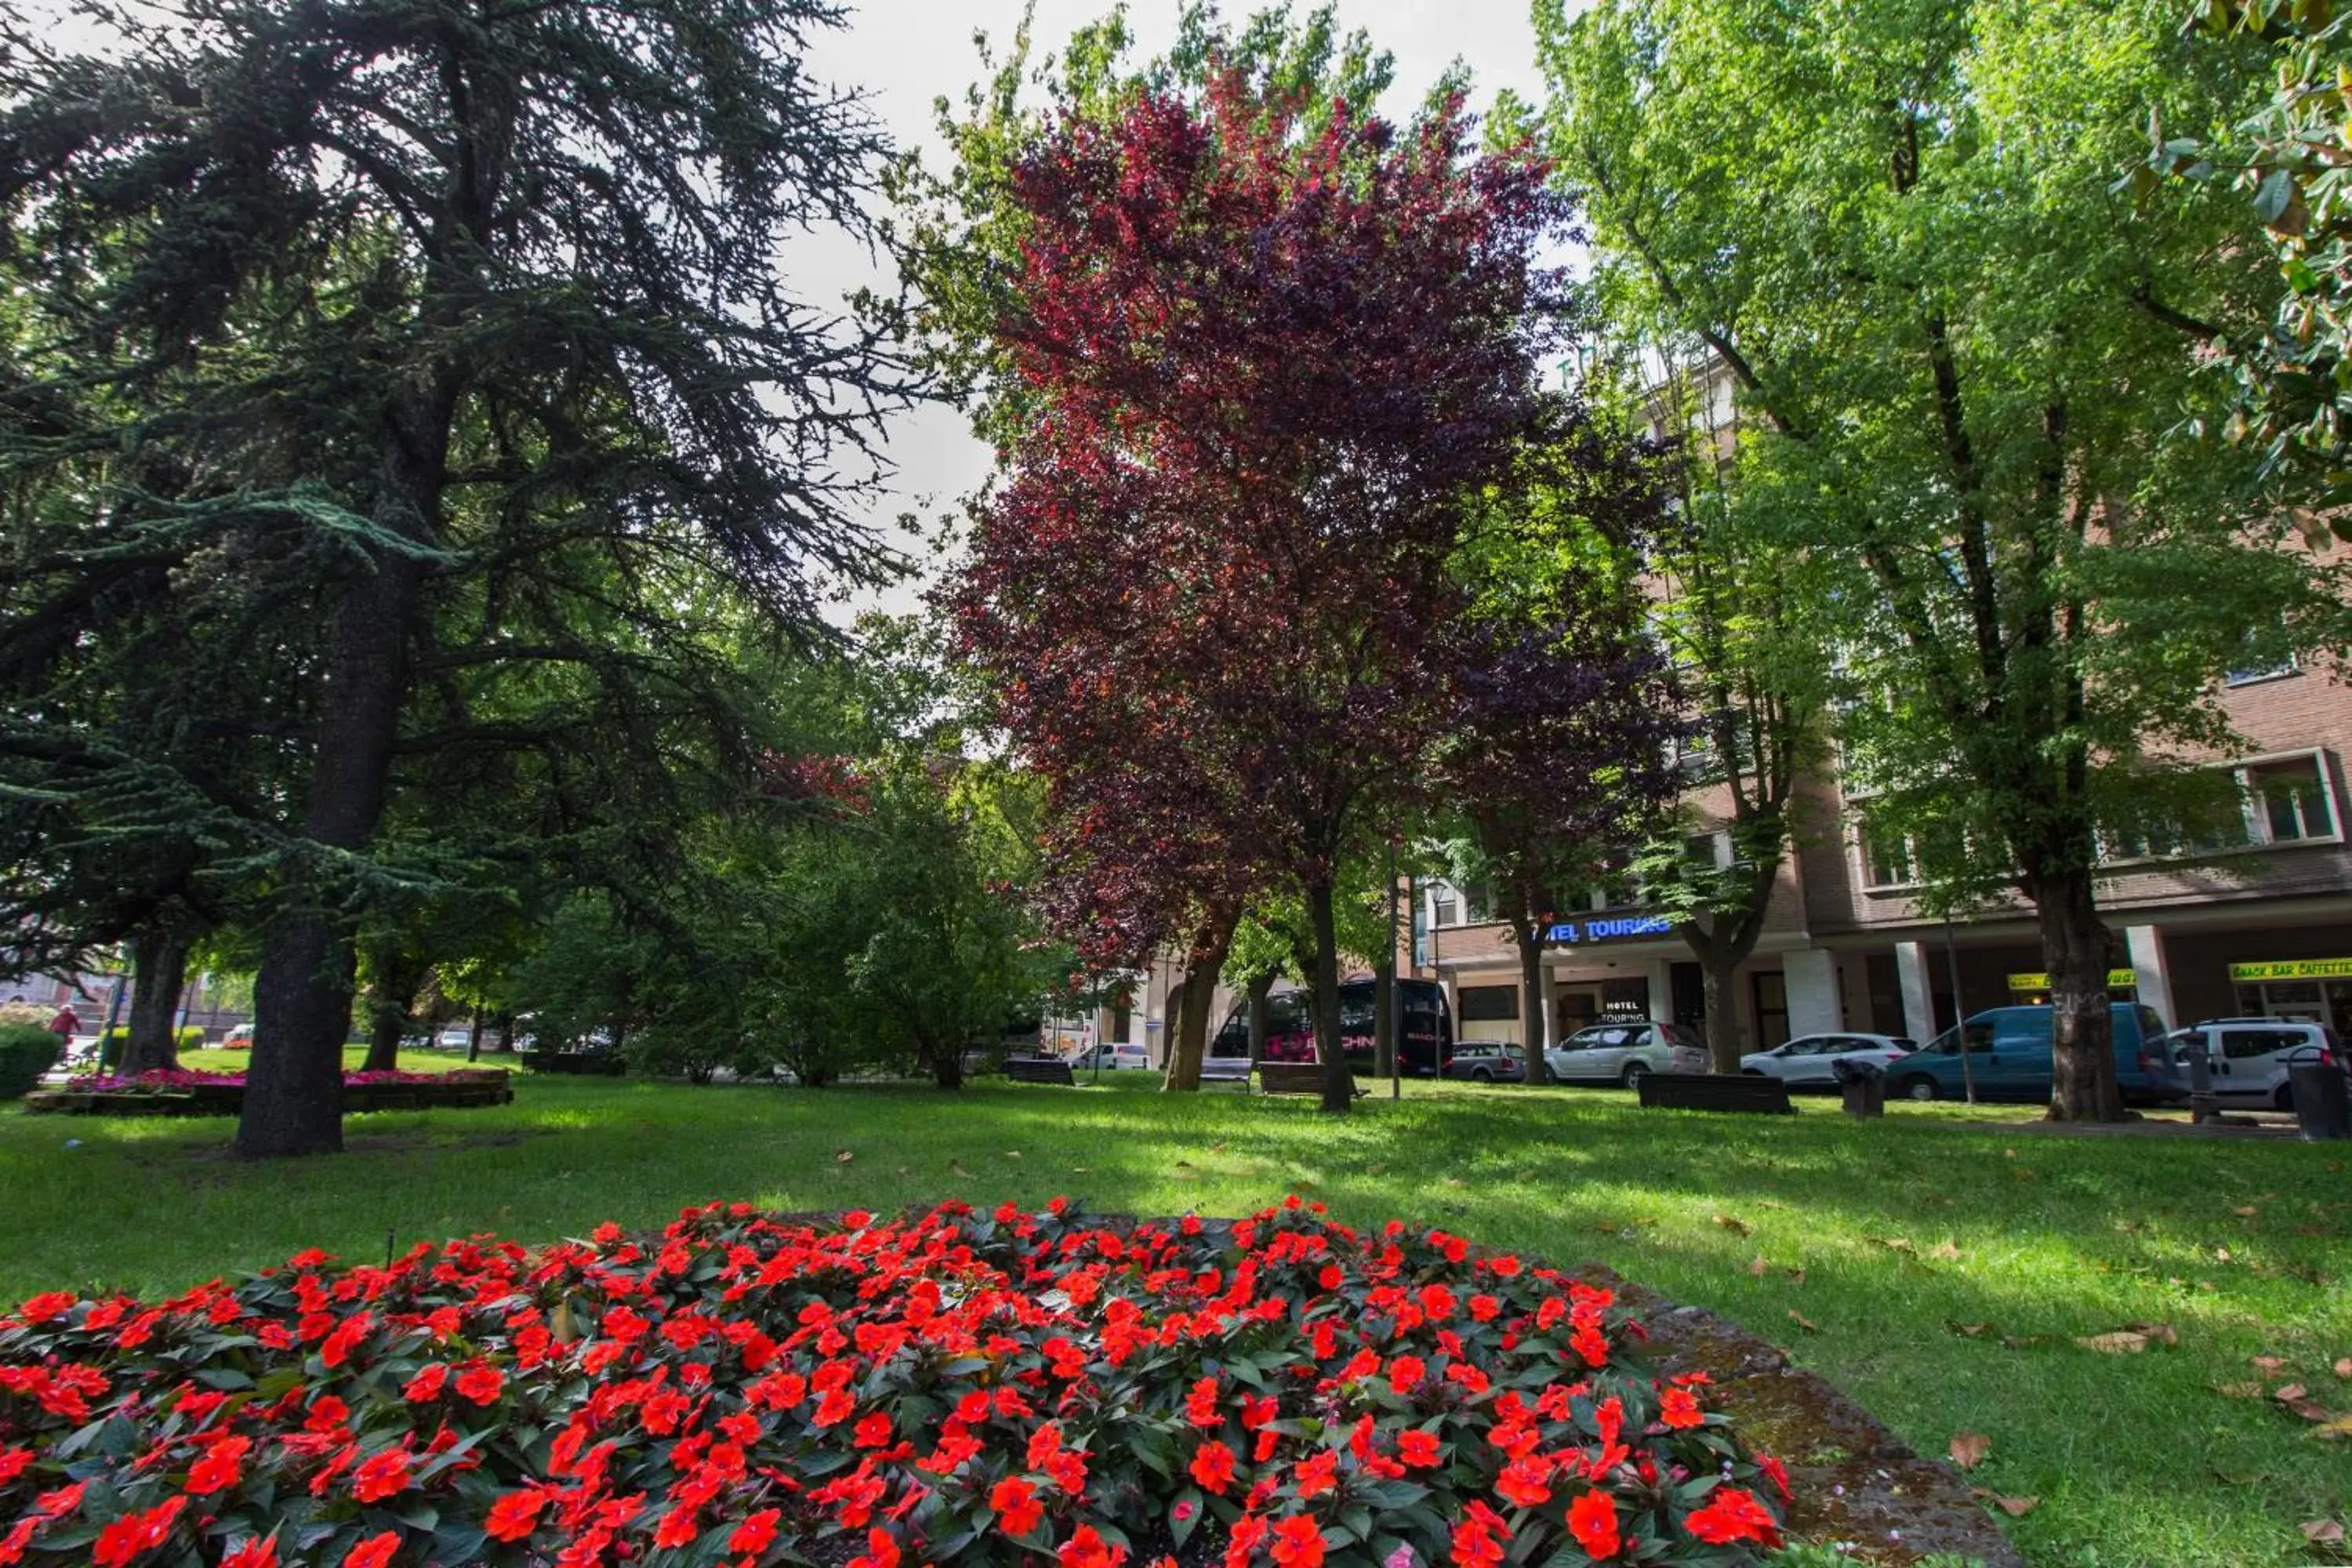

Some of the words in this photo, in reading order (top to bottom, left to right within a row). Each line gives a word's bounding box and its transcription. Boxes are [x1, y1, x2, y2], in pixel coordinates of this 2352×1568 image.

[2271, 964, 2294, 975] BAR
[1606, 1001, 1639, 1011] HOTEL
[1601, 1013, 1644, 1023] TOURING
